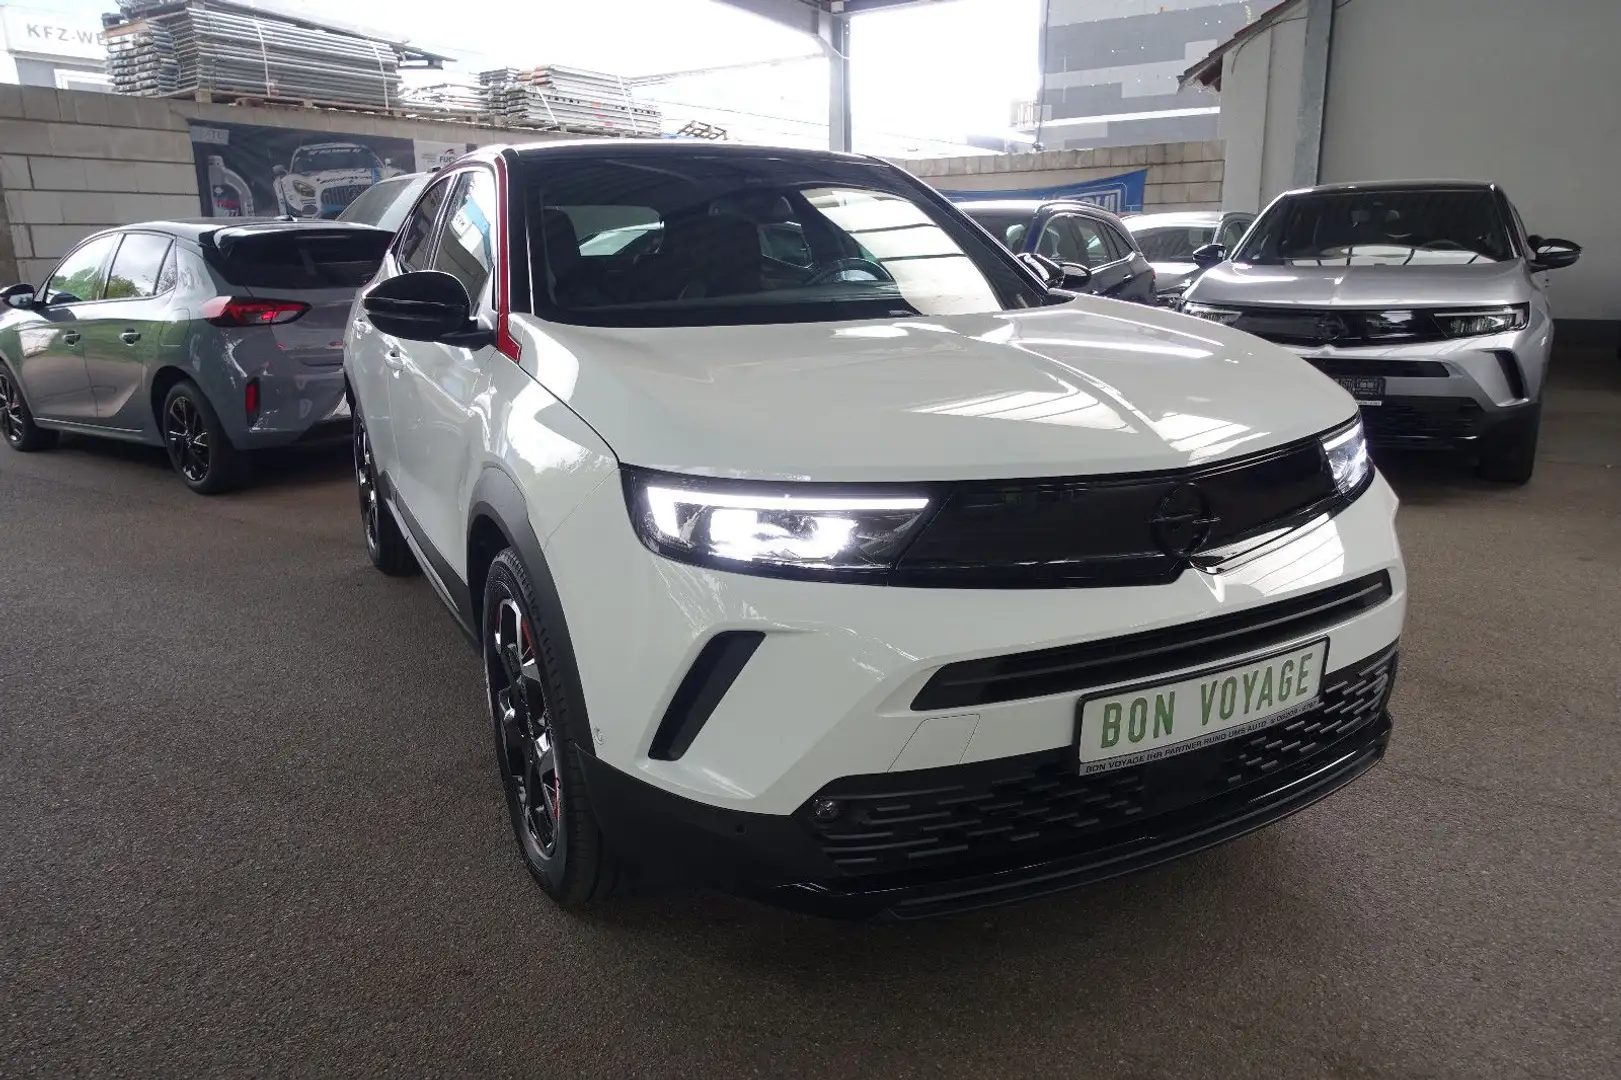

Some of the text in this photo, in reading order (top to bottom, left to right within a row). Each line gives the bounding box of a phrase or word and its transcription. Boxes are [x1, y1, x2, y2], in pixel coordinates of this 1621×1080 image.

[1100, 652, 1313, 749] BON VOYAGE
[1085, 762, 1106, 774] BON
[1108, 755, 1145, 769] VOYAGE
[1146, 750, 1163, 761] IHR
[1164, 741, 1203, 757] PARTNER
[1203, 732, 1226, 746] RUND
[1247, 720, 1267, 732] AUTO
